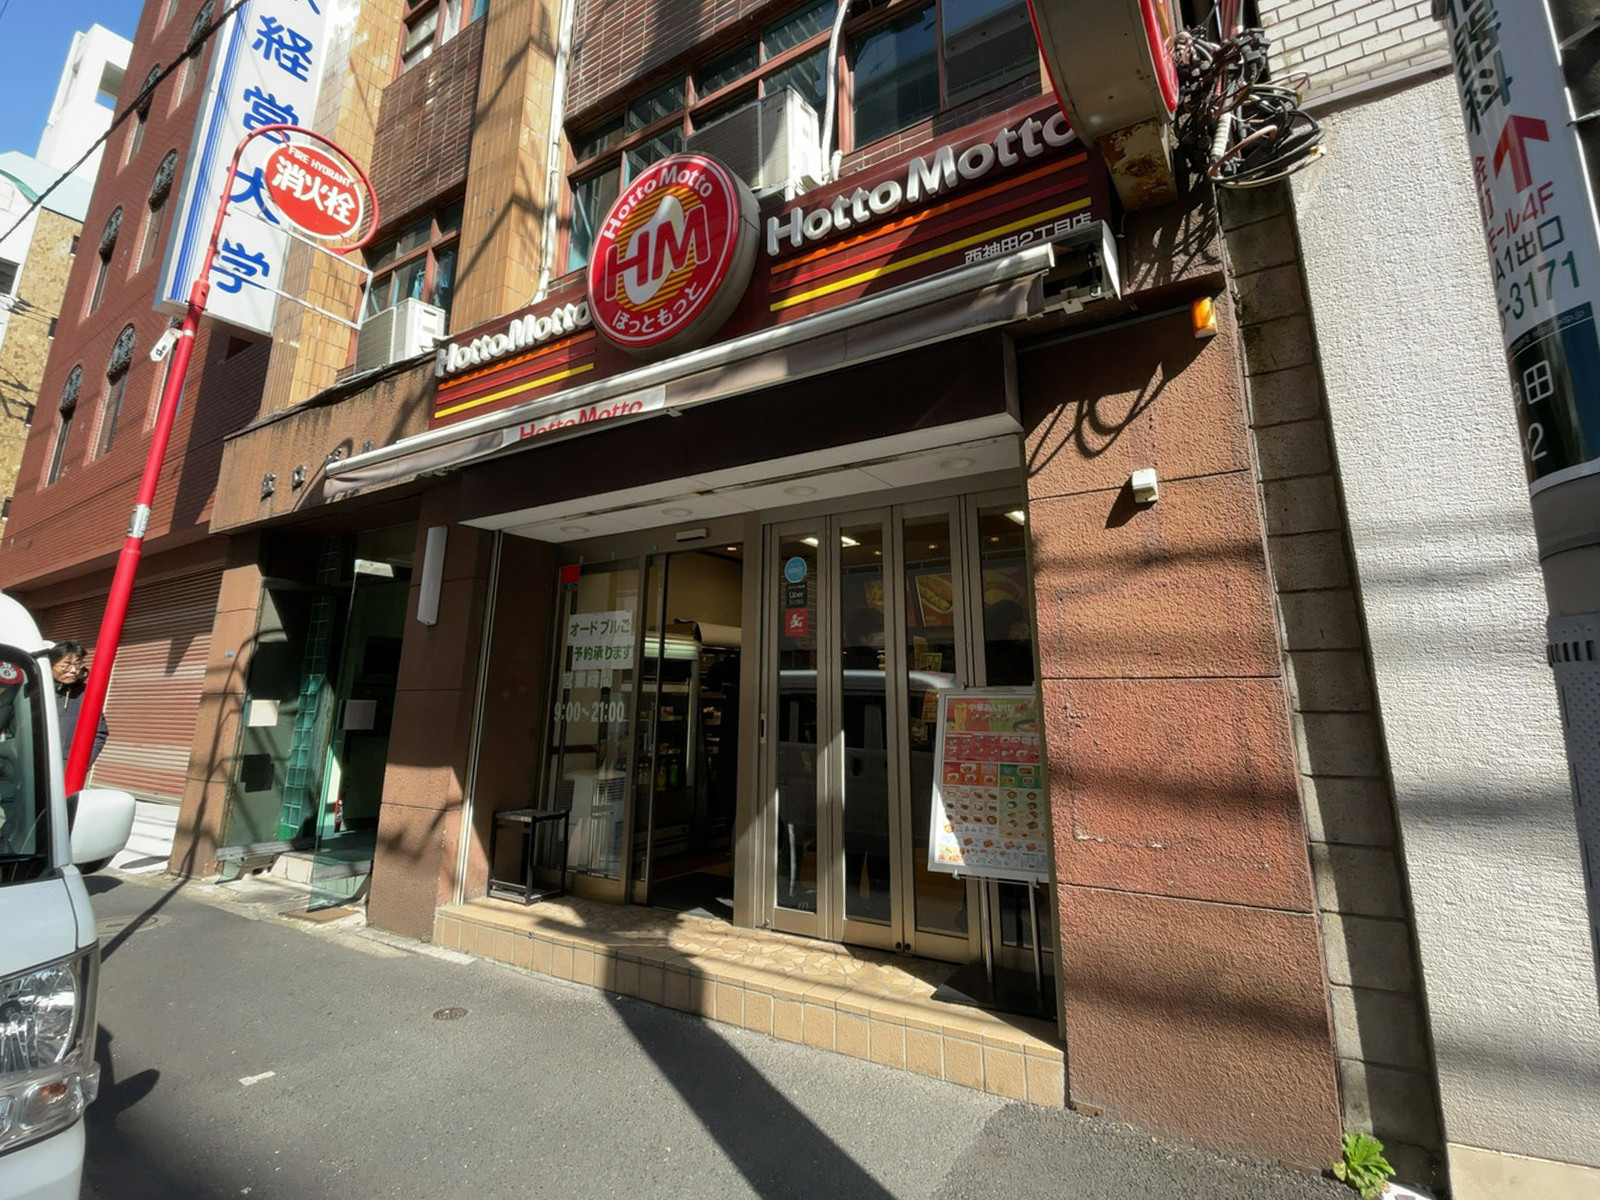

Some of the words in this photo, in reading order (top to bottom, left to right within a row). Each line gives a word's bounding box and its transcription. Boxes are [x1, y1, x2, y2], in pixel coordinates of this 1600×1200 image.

[211, 0, 321, 294] 経営大学
[288, 147, 309, 165] FIRE
[310, 158, 352, 186] HYDRANT
[270, 155, 357, 226] 消火栓
[612, 281, 704, 335] ほっともっと
[570, 618, 631, 638] オードブルご
